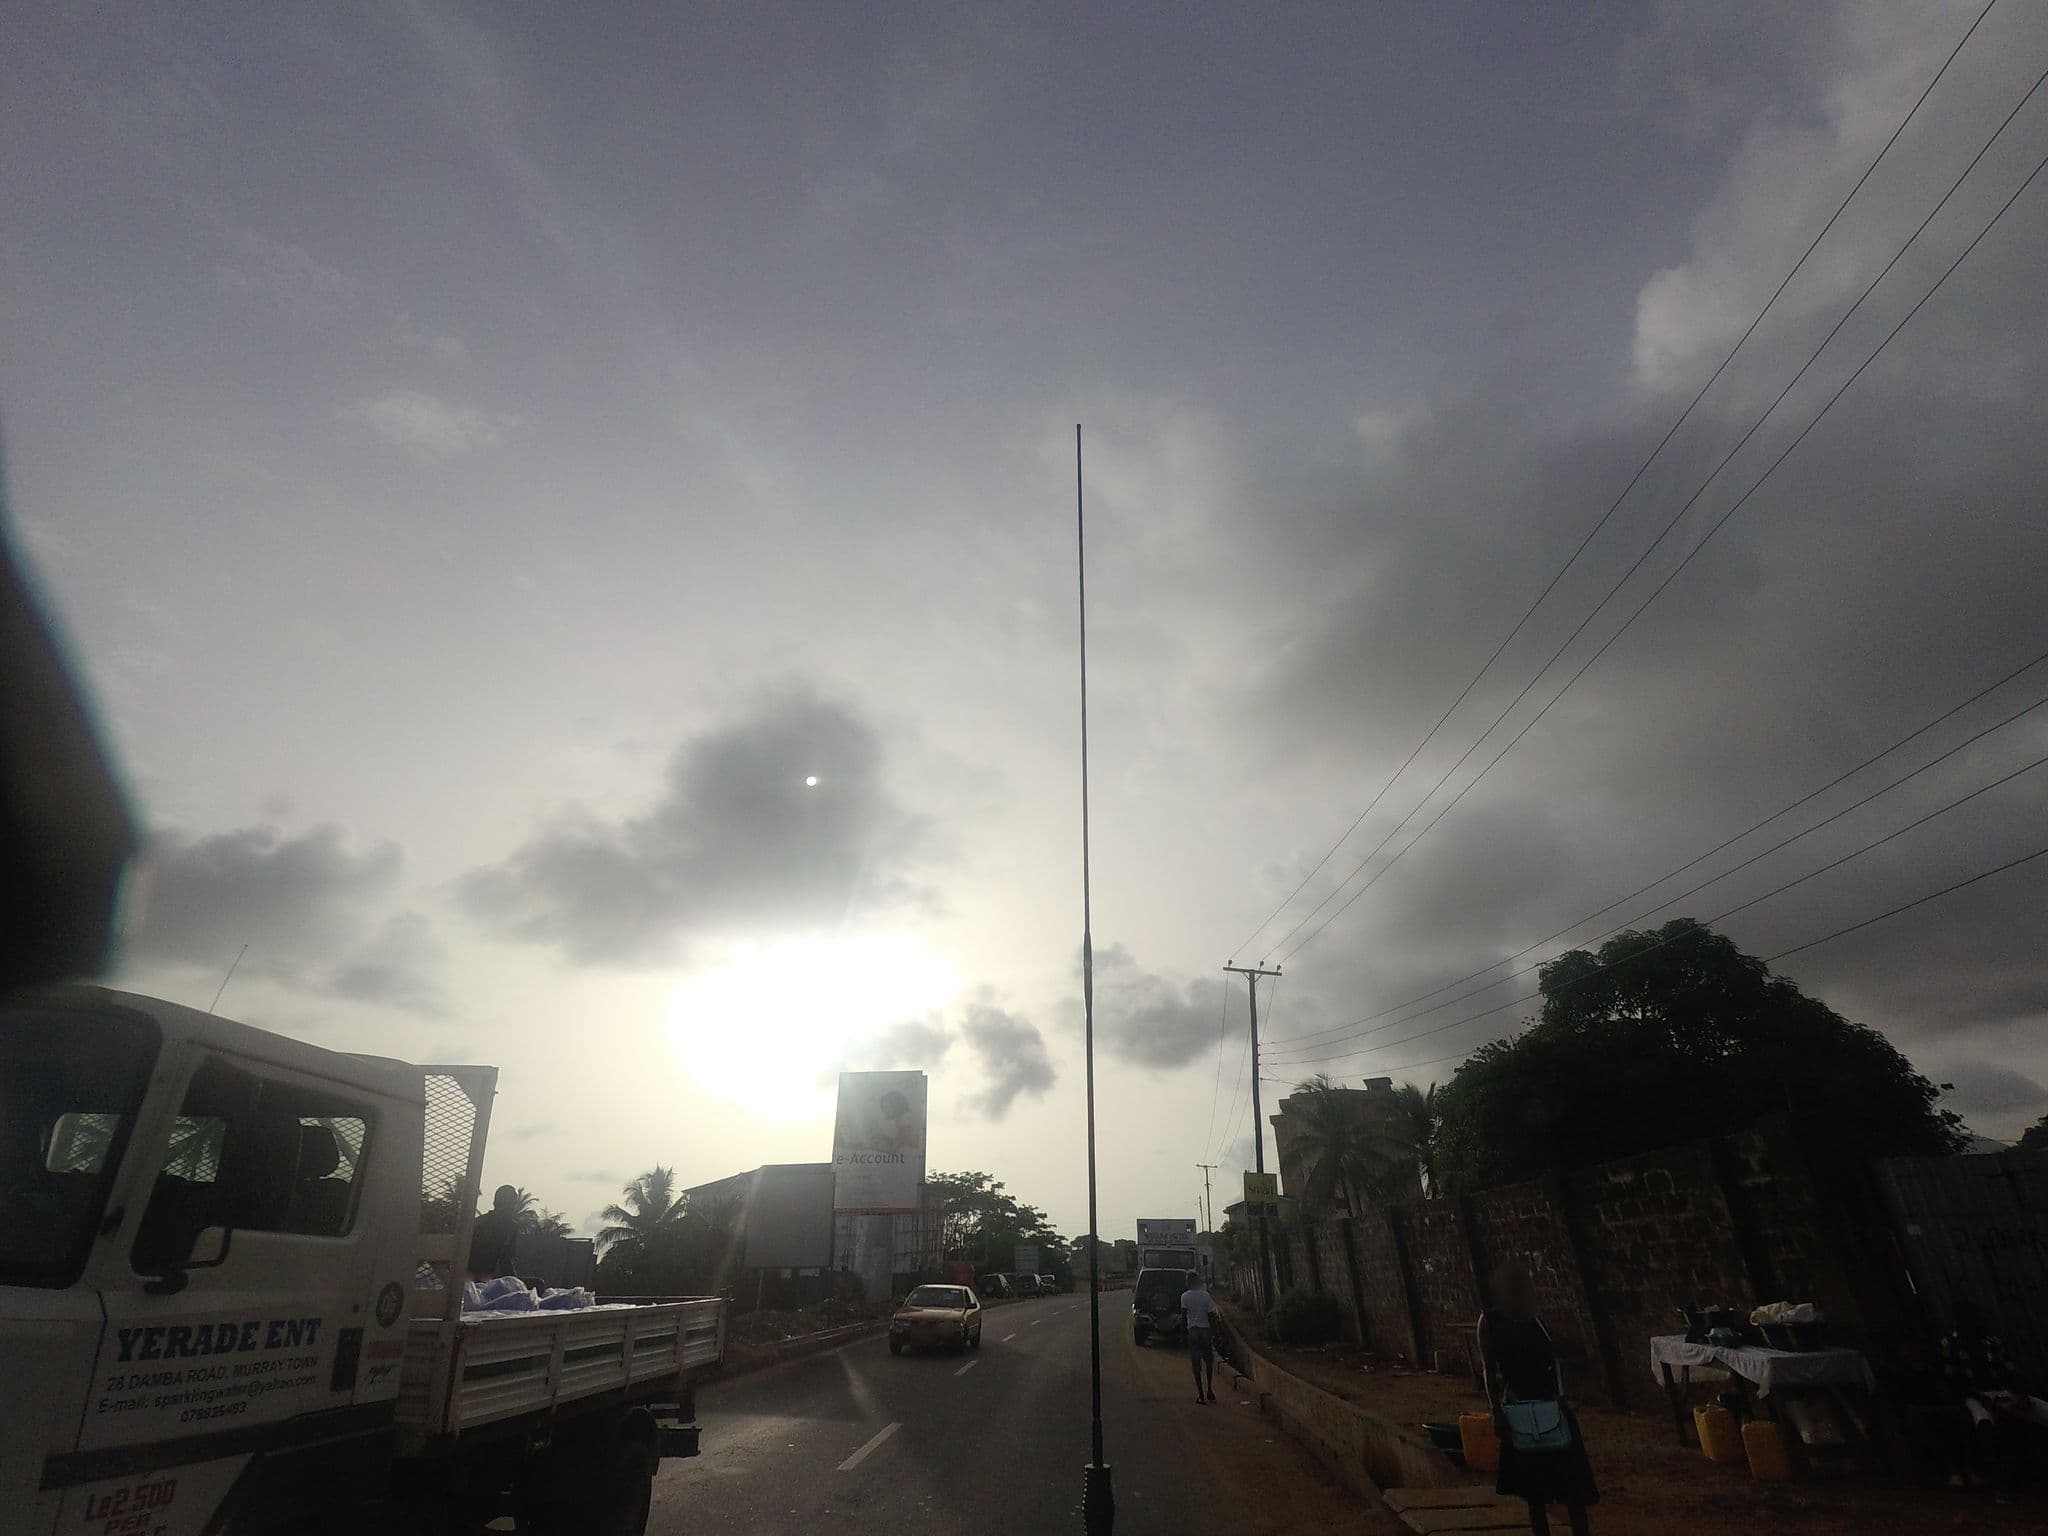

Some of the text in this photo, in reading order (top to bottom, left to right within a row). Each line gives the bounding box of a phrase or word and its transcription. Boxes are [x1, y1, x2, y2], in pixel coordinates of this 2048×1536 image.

[836, 1151, 904, 1165] e-Account
[117, 1317, 322, 1362] YERADE ENT
[107, 1376, 125, 1393] 28
[128, 1372, 183, 1390] DAMBA
[233, 1360, 284, 1378] MURRAY
[287, 1355, 319, 1370] TOWN
